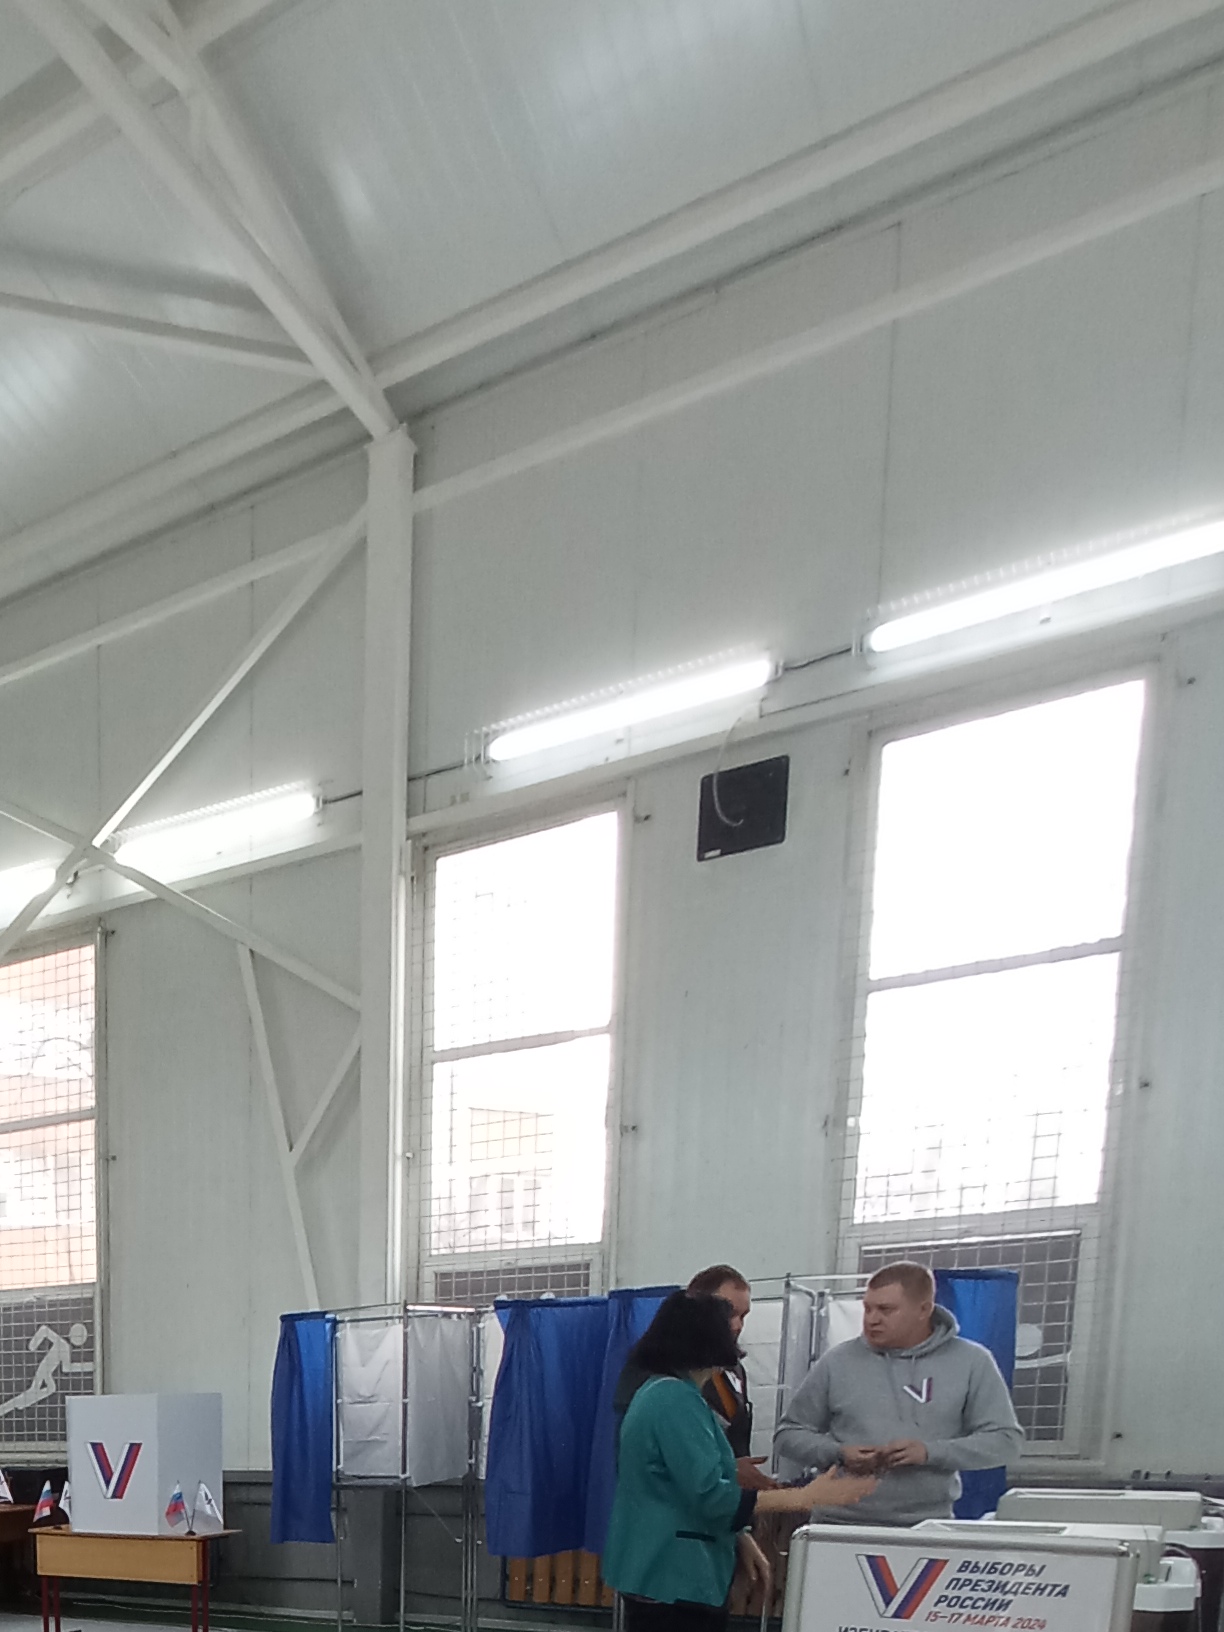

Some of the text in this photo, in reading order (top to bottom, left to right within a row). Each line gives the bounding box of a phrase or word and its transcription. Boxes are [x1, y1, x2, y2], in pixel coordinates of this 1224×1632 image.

[956, 1560, 1047, 1577] ВЫБОРЫ
[944, 1577, 1071, 1598] ПРЕЗИДЕНТА
[933, 1594, 1013, 1612] РОССИИ
[962, 1613, 1012, 1628] МАРТА
[1011, 1617, 1048, 1631] 2024
